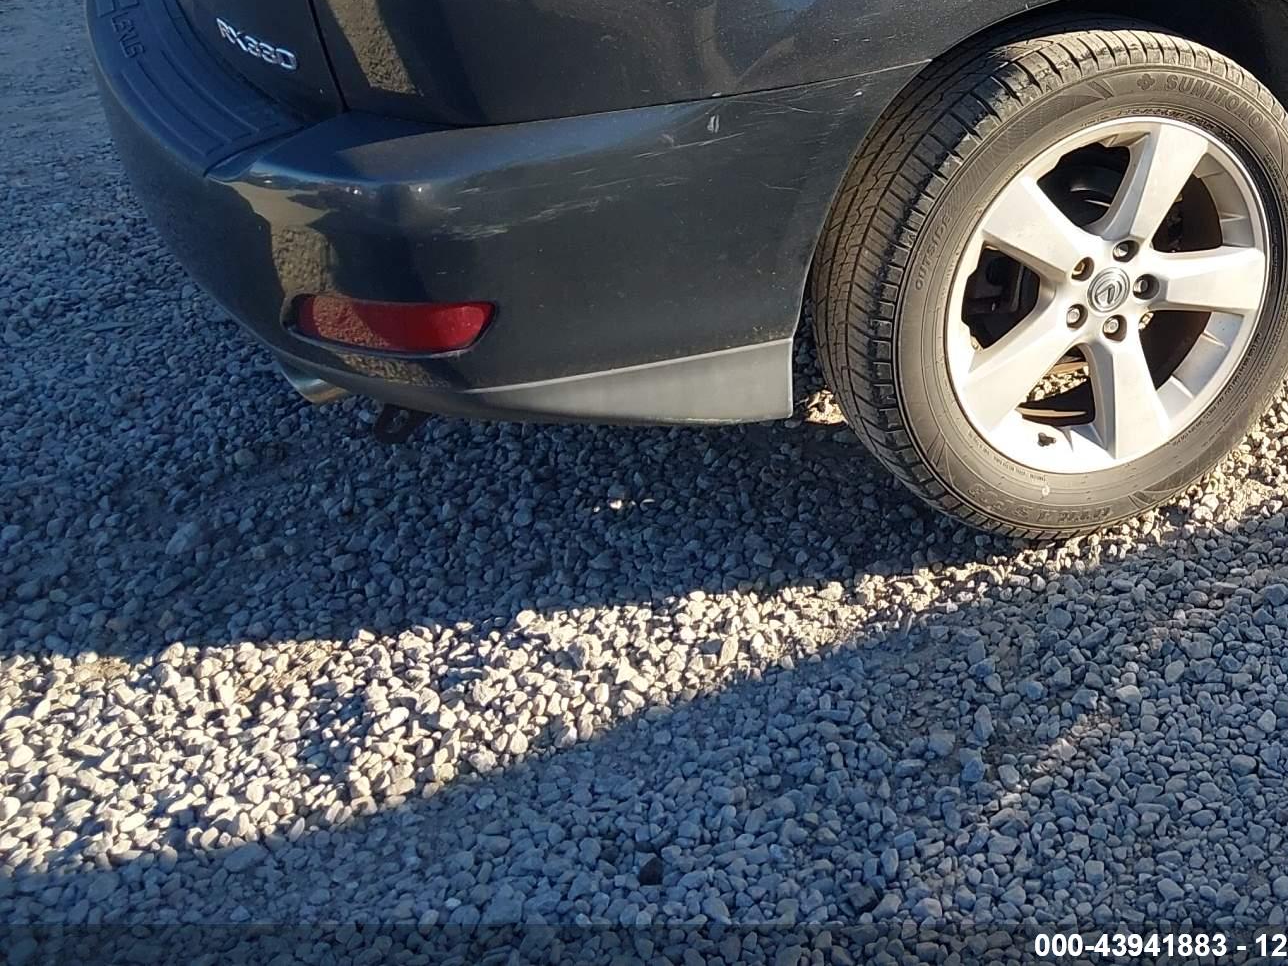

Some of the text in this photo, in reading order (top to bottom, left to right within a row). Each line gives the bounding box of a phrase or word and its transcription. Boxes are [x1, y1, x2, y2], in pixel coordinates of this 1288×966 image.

[111, 11, 147, 60] LEXUS
[1165, 74, 1265, 129] SUMITOMO
[915, 214, 951, 291] OUTSIDE
